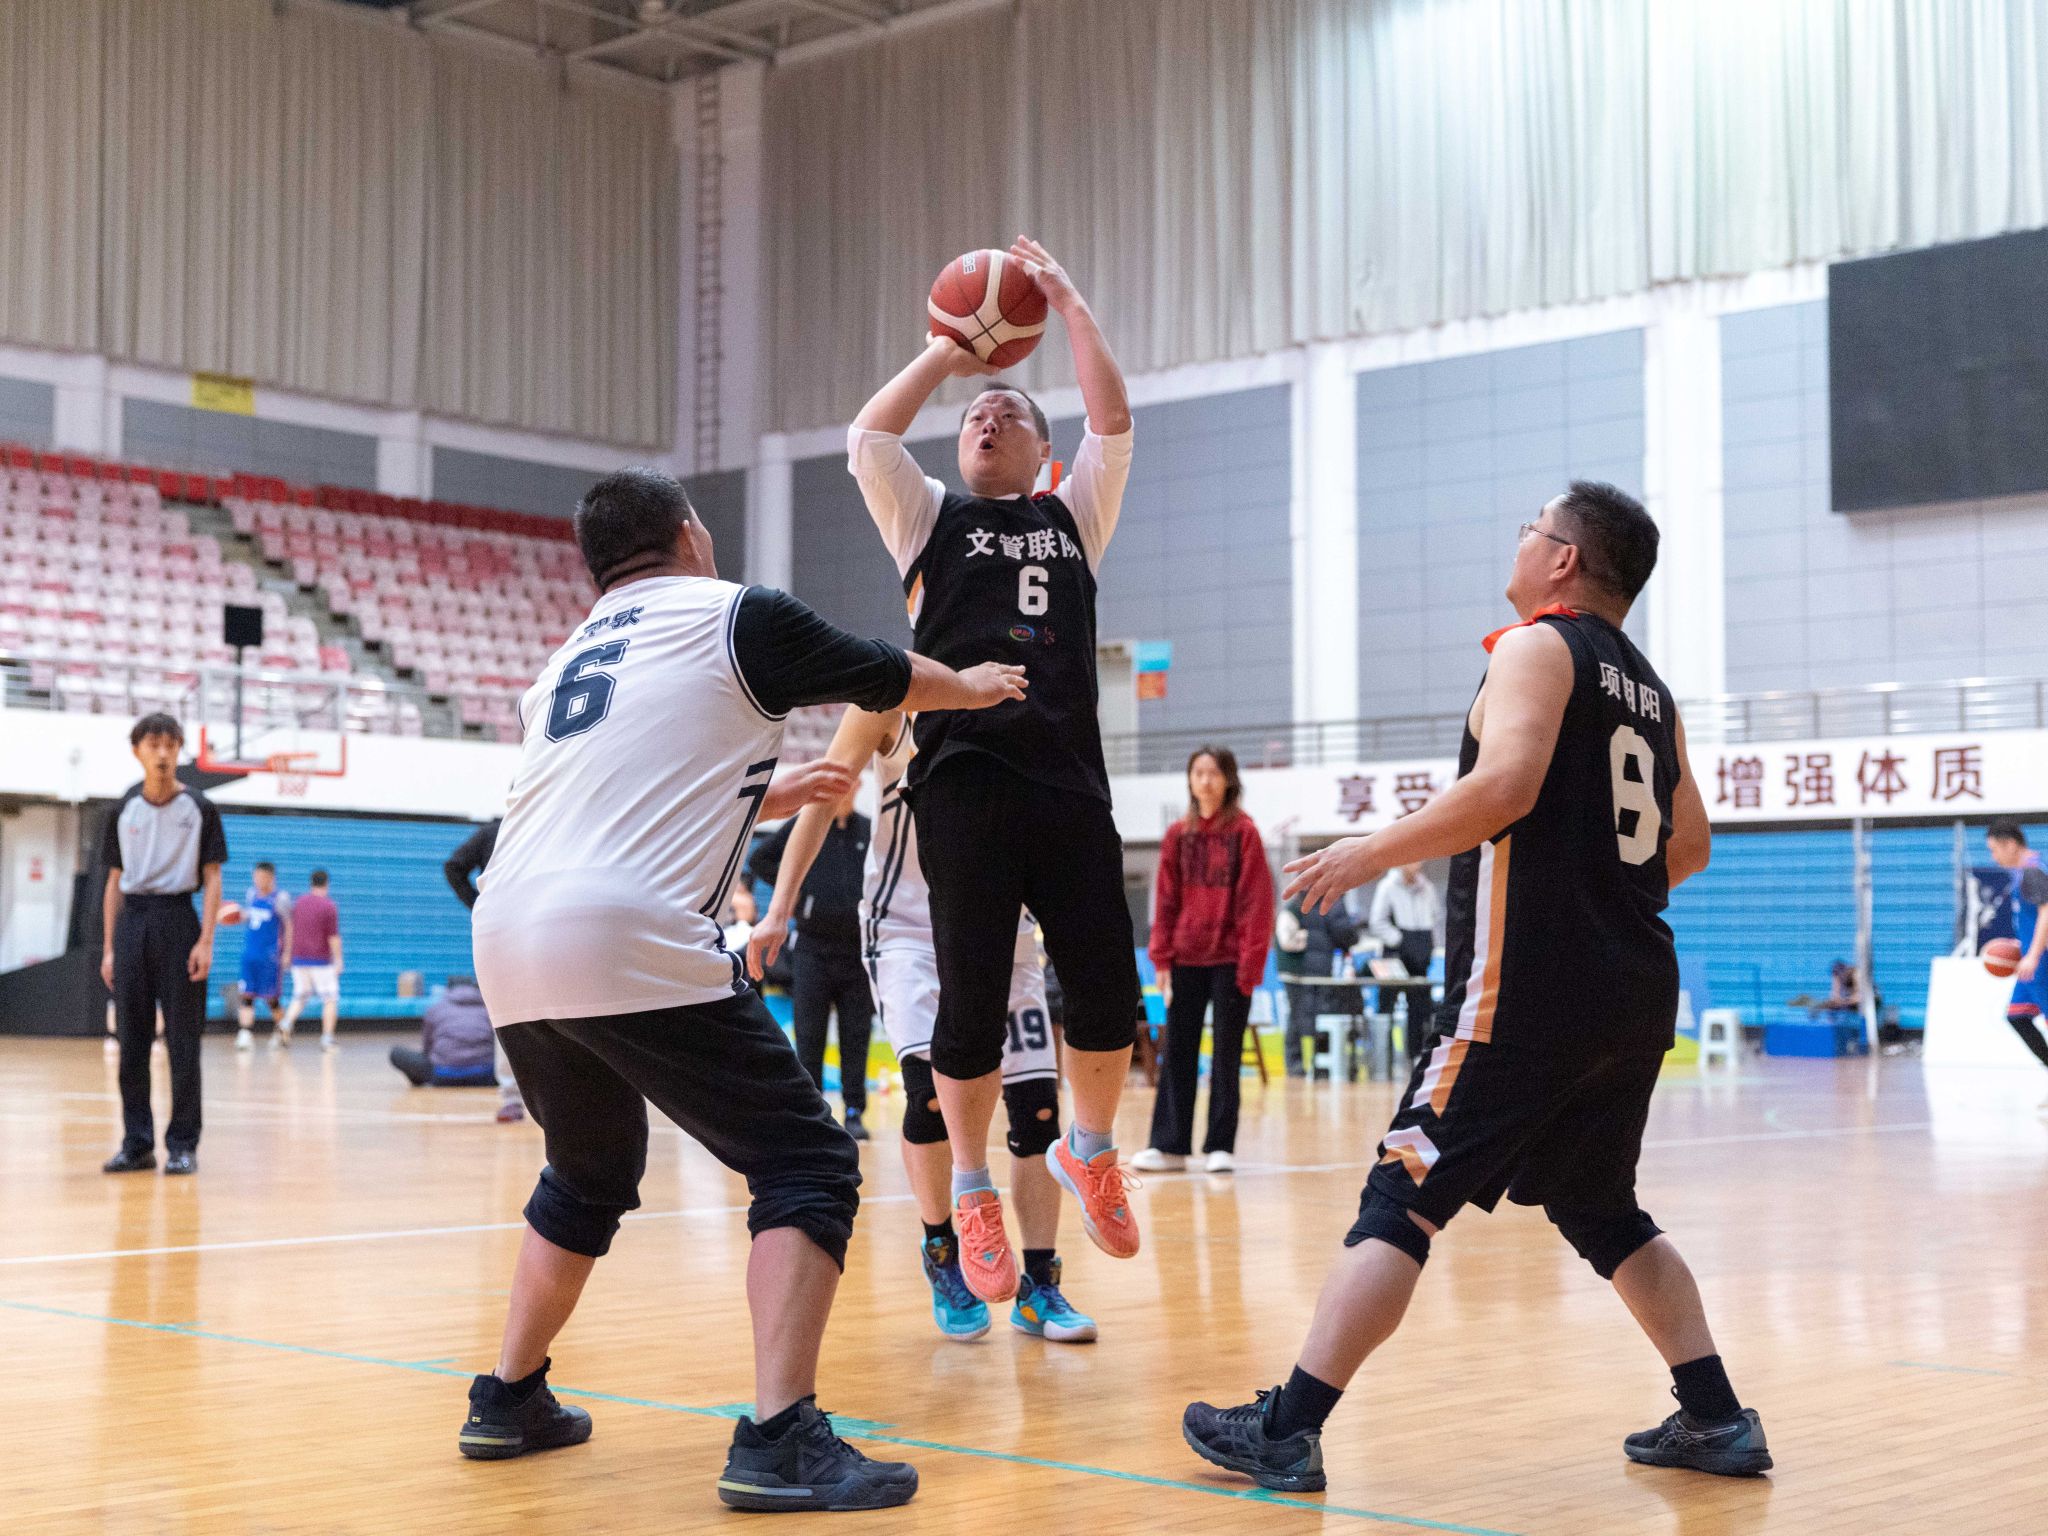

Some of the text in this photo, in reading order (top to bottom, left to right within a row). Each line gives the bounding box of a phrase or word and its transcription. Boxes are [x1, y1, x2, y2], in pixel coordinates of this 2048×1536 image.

[966, 527, 1082, 561] 文管联队
[1018, 565, 1049, 616] 6
[545, 639, 630, 743] 6
[1716, 745, 1984, 809] 增强体质
[1008, 1008, 1048, 1053] 19
